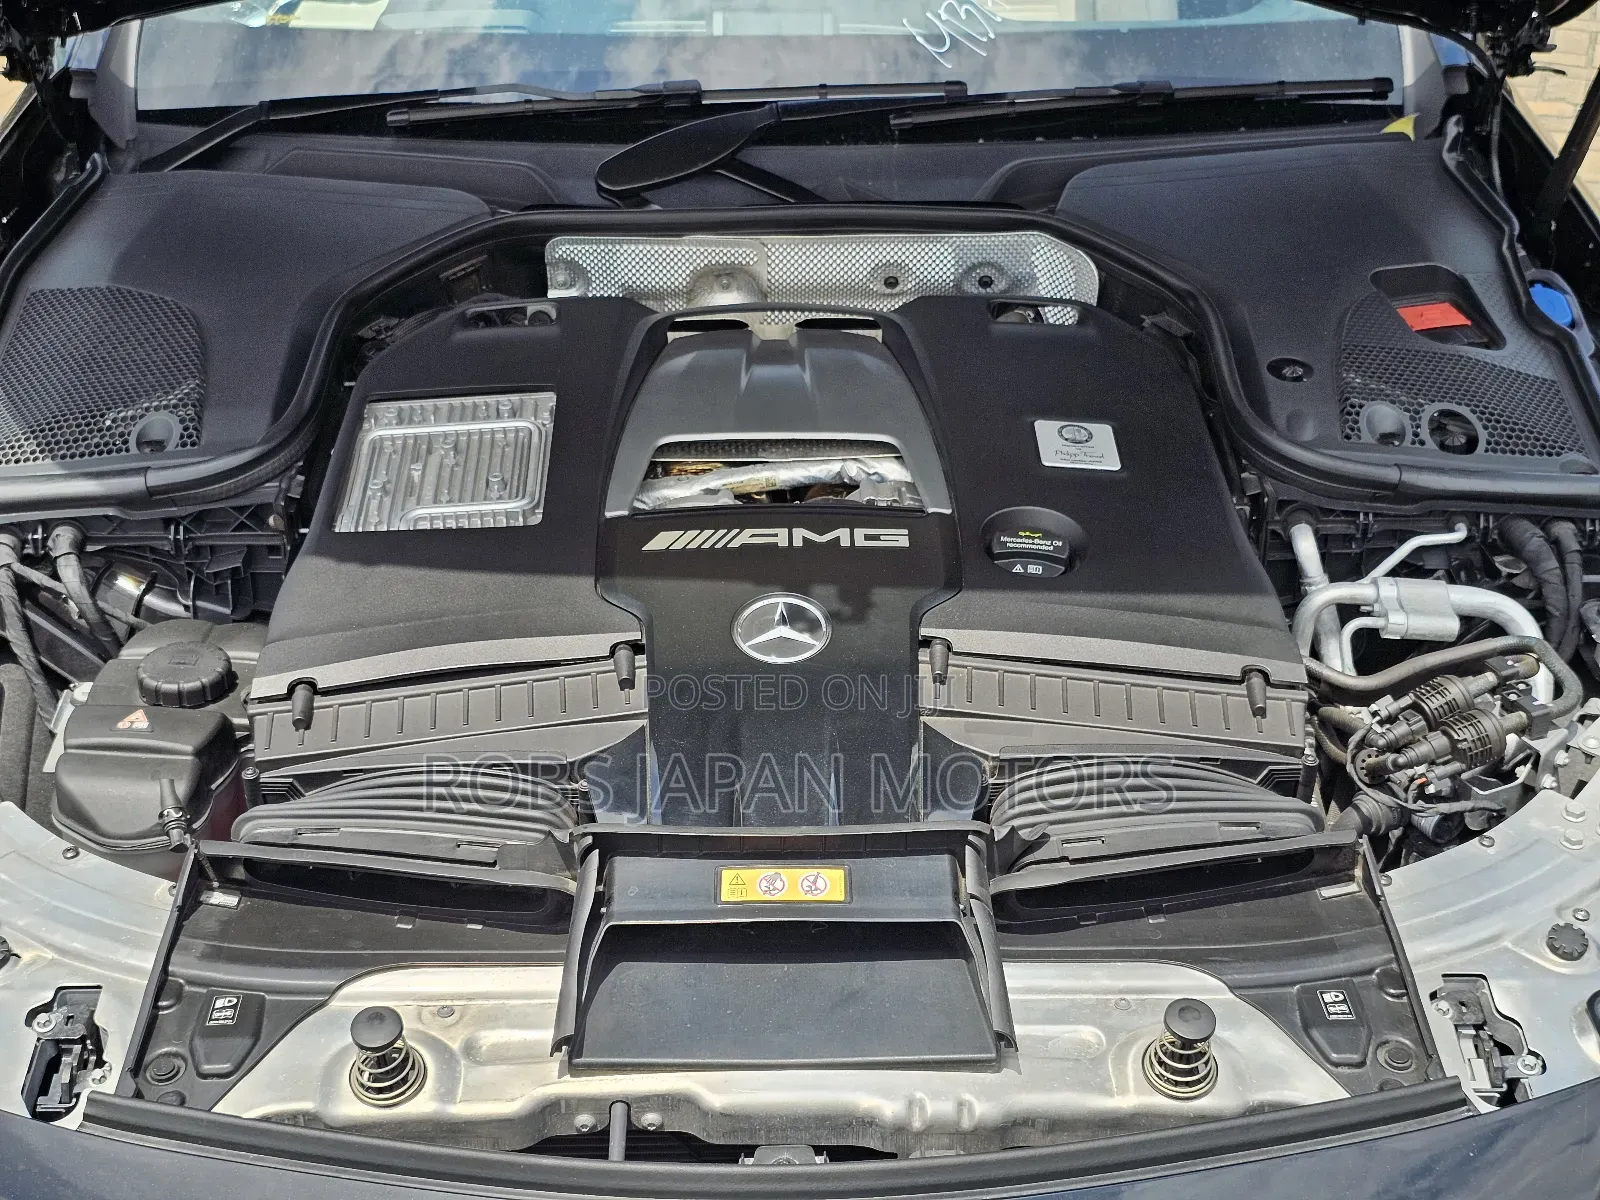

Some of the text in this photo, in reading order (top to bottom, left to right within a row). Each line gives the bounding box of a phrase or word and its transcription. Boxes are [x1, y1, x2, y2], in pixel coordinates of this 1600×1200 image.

[726, 527, 910, 548] AMG
[1000, 535, 1052, 546] Mercedes-Benz
[1006, 542, 1054, 551] recommended
